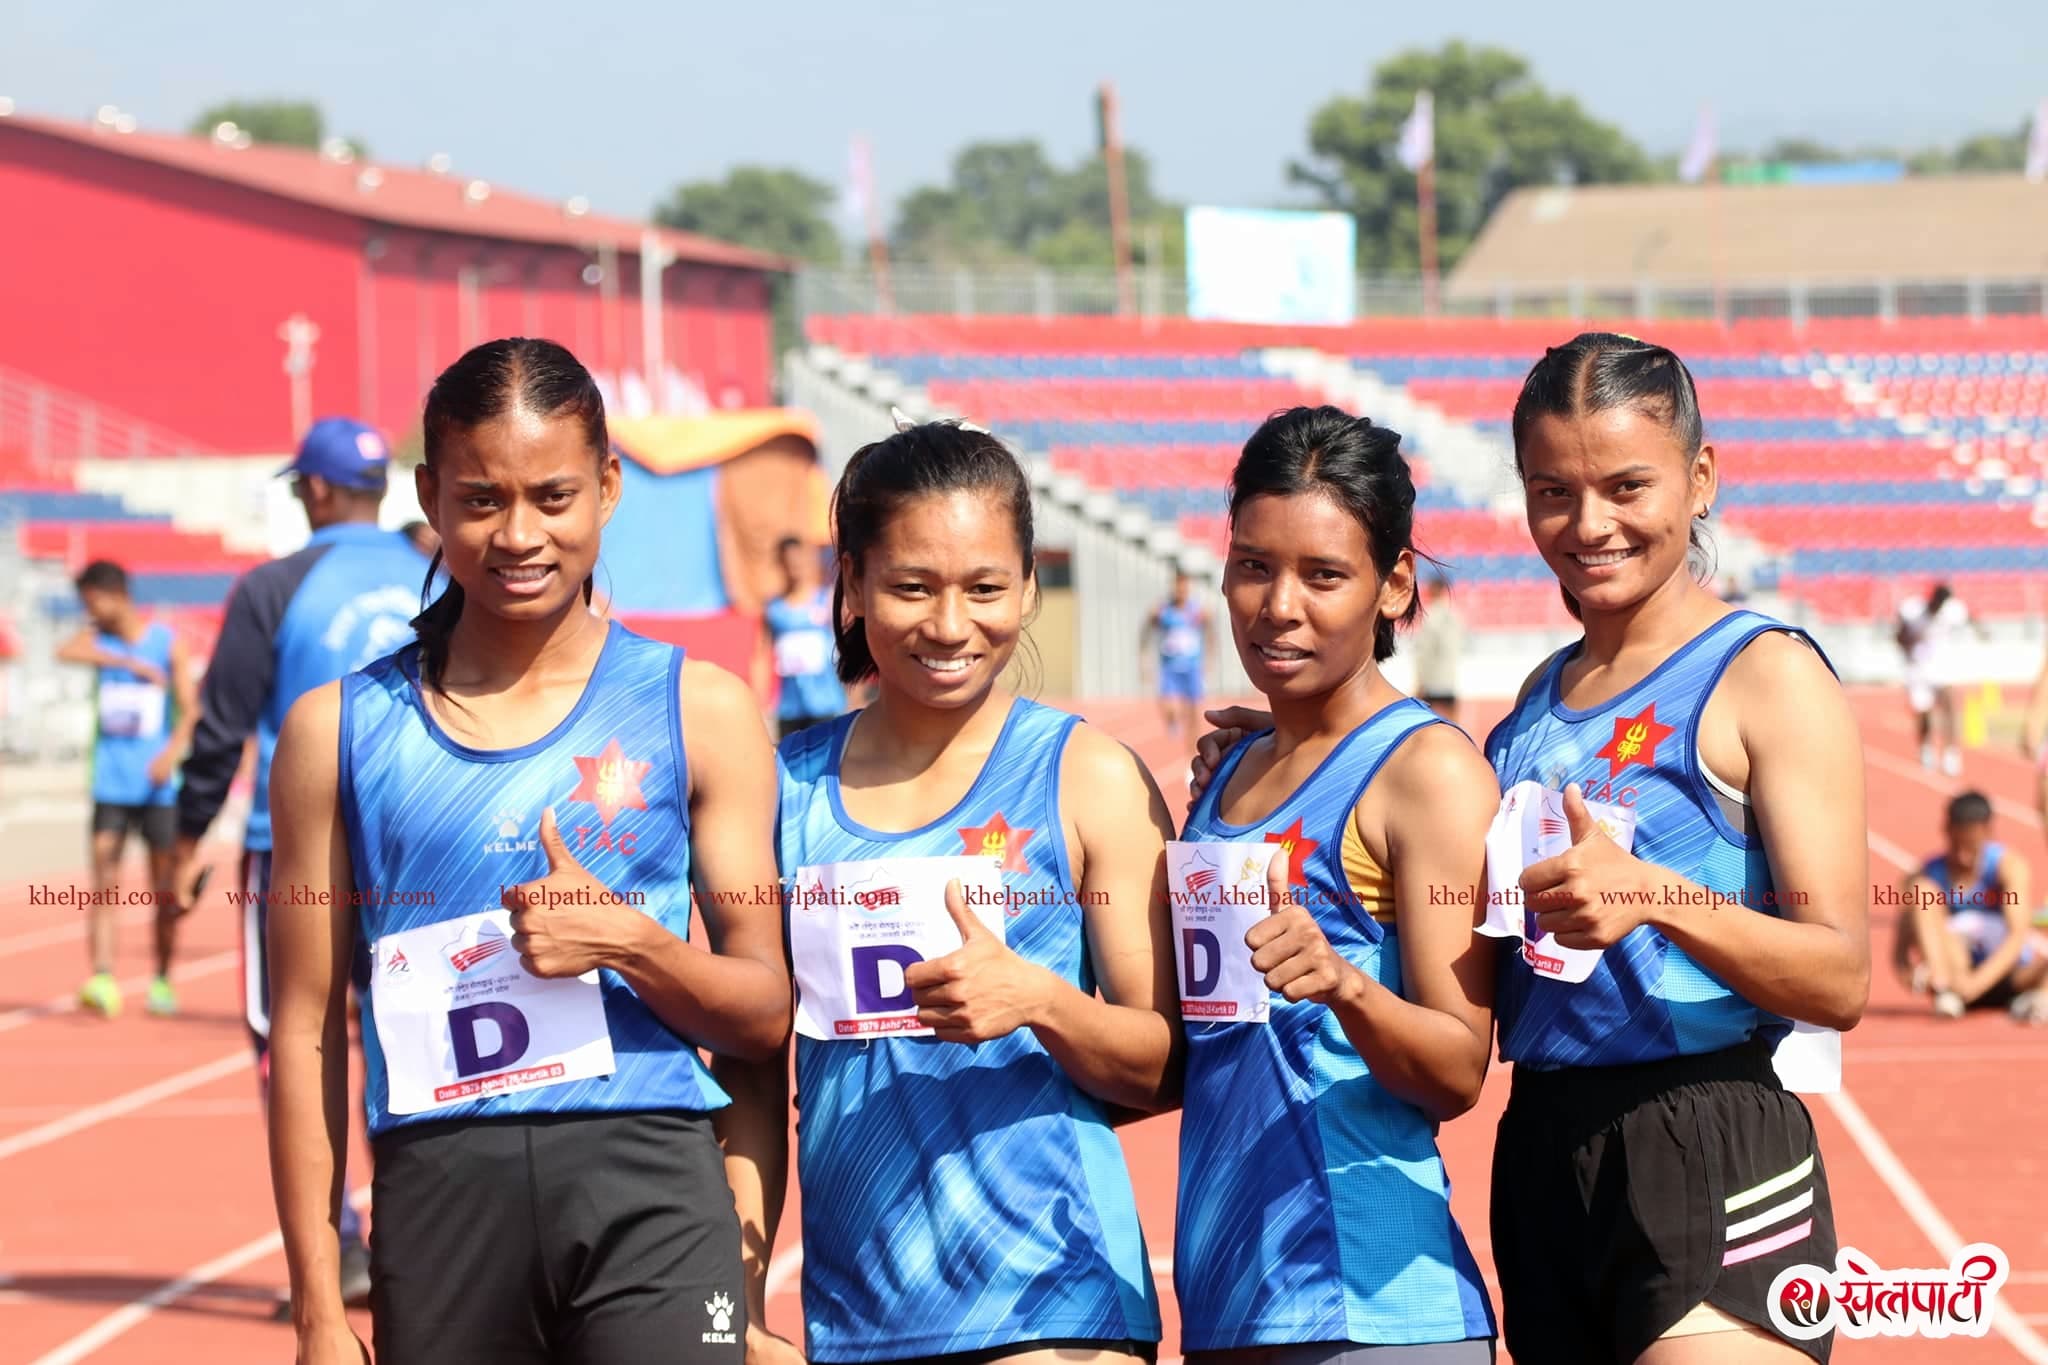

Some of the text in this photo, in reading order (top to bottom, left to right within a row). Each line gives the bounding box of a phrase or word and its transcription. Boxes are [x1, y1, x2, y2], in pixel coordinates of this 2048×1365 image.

[1583, 779, 1639, 808] TAC
[484, 840, 537, 854] KELME
[574, 827, 638, 856] TAC
[1182, 928, 1221, 997] D
[851, 944, 925, 1014] D
[447, 1001, 530, 1078] D
[439, 1088, 458, 1100] Date:
[702, 1332, 736, 1344] KELME
